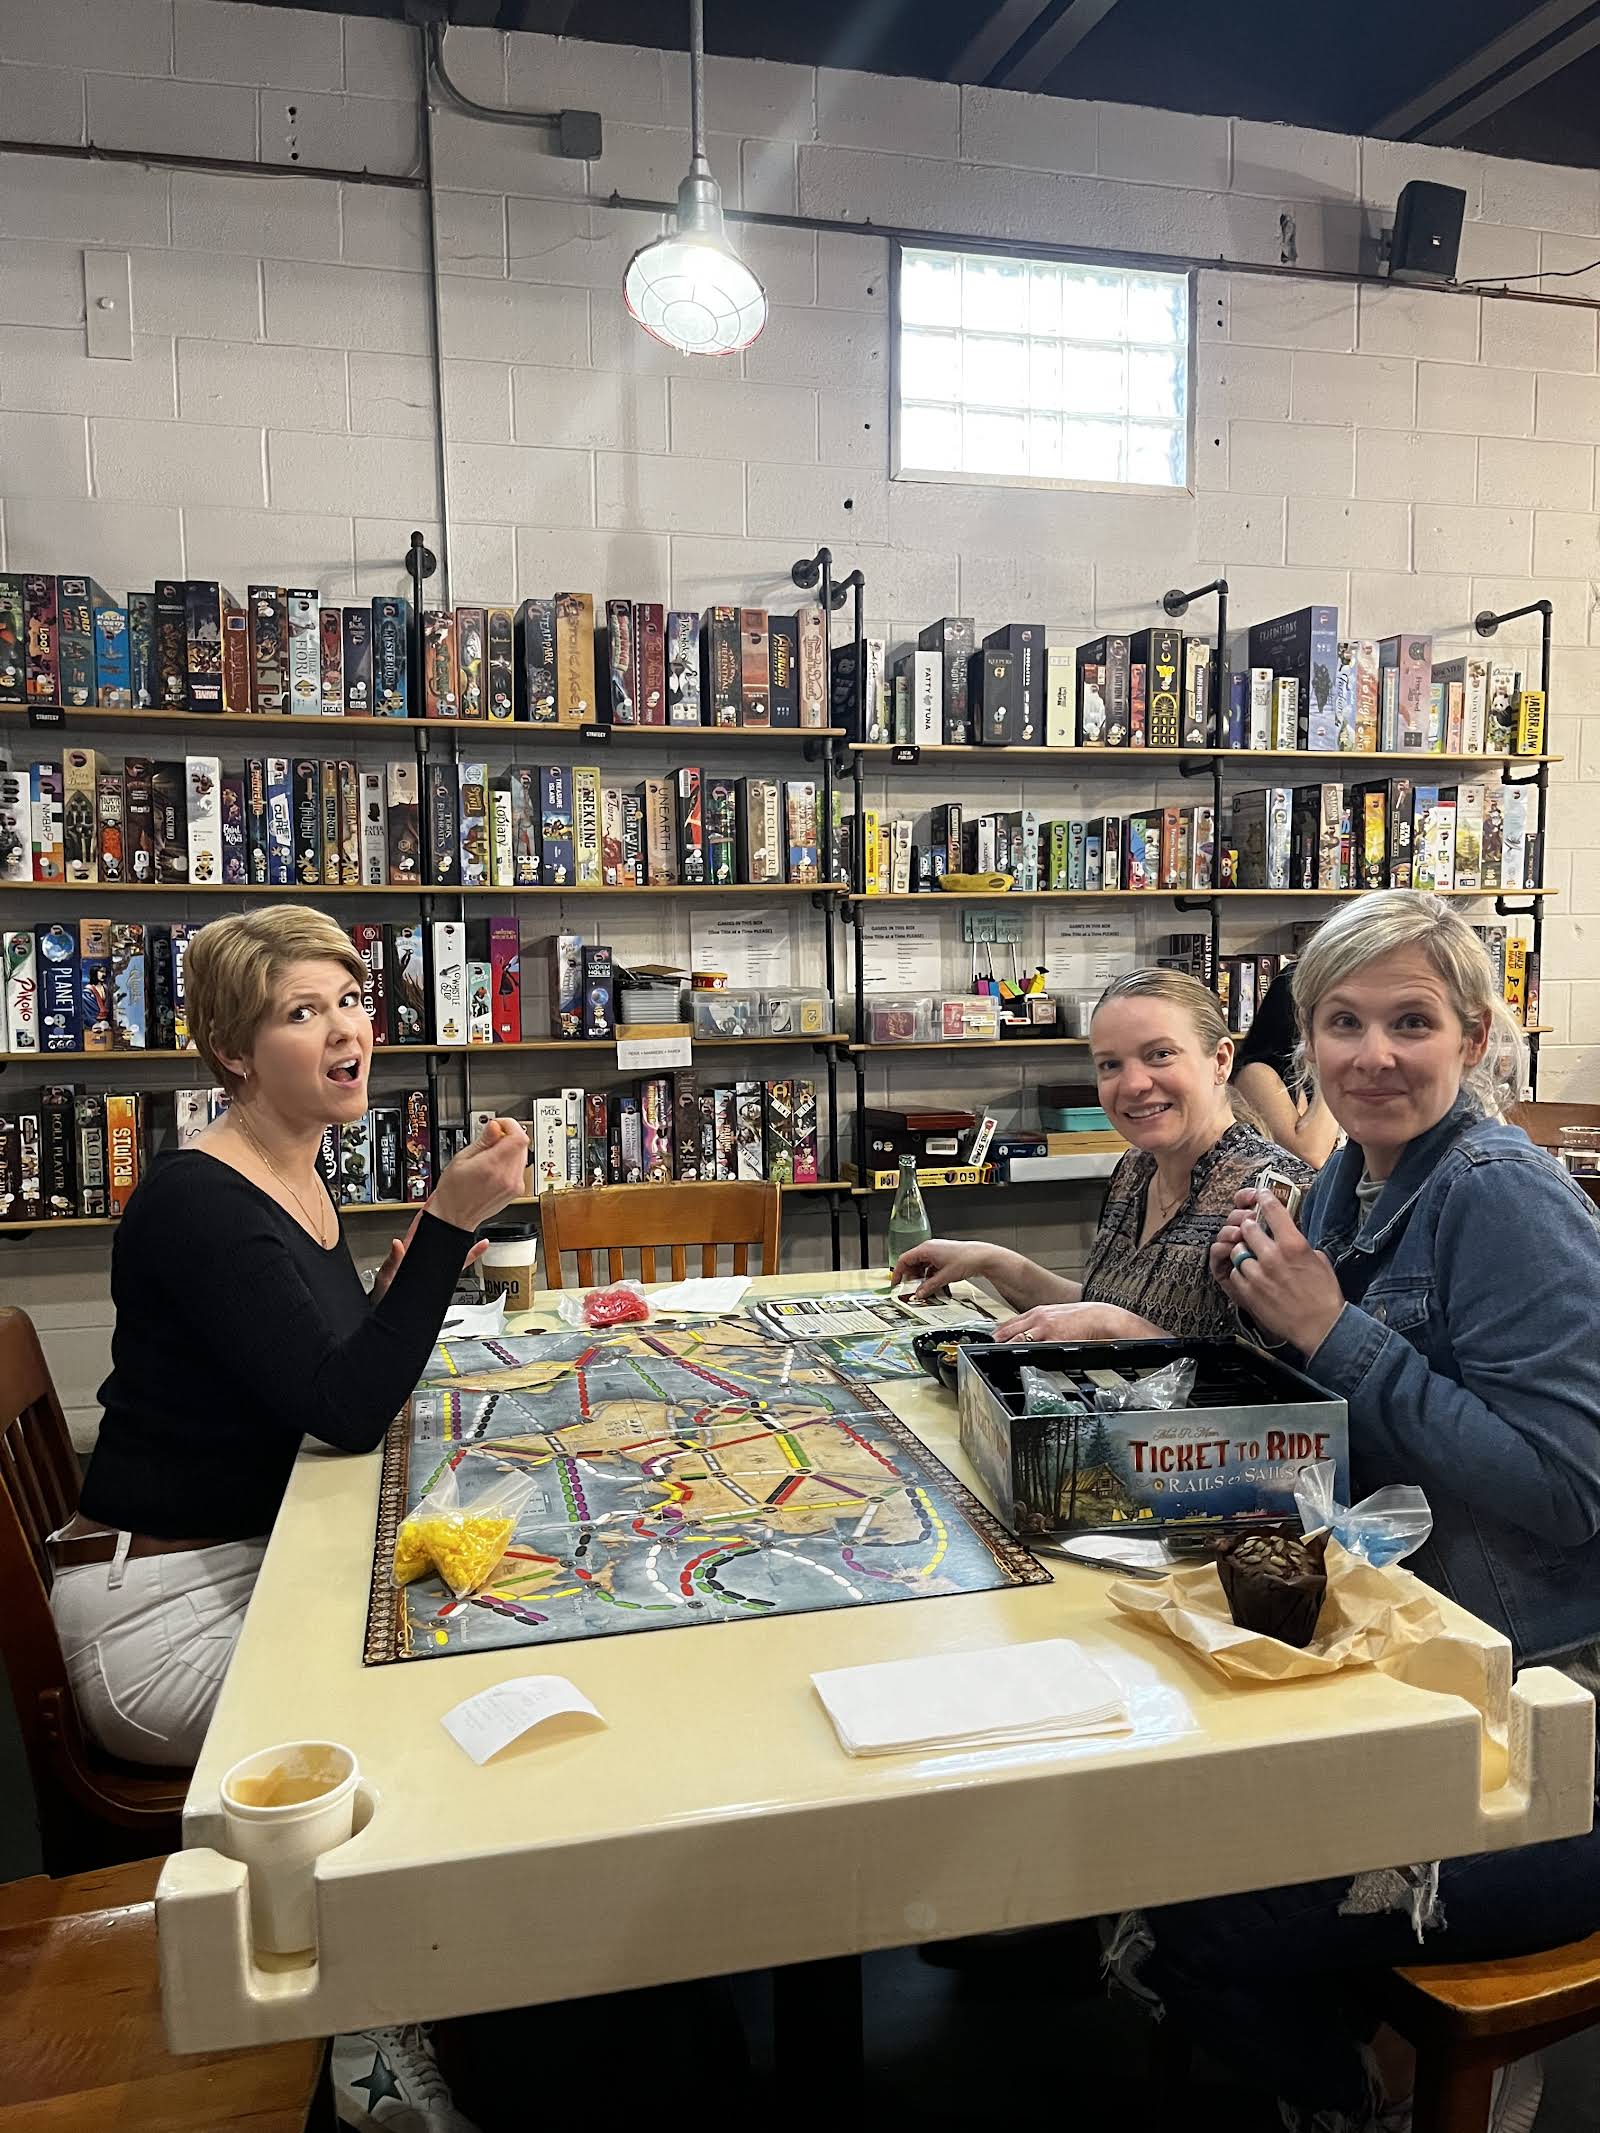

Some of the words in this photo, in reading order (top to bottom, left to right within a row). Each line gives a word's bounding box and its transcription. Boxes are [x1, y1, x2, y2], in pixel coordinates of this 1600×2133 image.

[40, 627, 50, 655] LOOP
[384, 630, 396, 685] MYSTERIUM
[1531, 725, 1541, 749] JAW
[274, 804, 283, 836] CURE
[495, 804, 508, 848] topiary
[584, 786, 596, 849] TREKKING
[658, 787, 670, 851] UNEARTH
[1328, 789, 1338, 822] SALOON
[767, 790, 777, 875] VITICULTURE
[51, 967, 75, 1017] PLANET
[452, 972, 461, 1006] WHISTLE
[52, 1113, 62, 1143] ROLL
[52, 1145, 65, 1190] PLAYER
[113, 1127, 133, 1175] RUMIS
[380, 1135, 390, 1177] BASE
[388, 1131, 397, 1178] SPACE
[1128, 1438, 1231, 1473] TICKET
[1234, 1440, 1260, 1462] TO
[1266, 1430, 1332, 1462] RIDE
[1168, 1475, 1226, 1494] RAILS
[1244, 1467, 1297, 1485] SAILS
